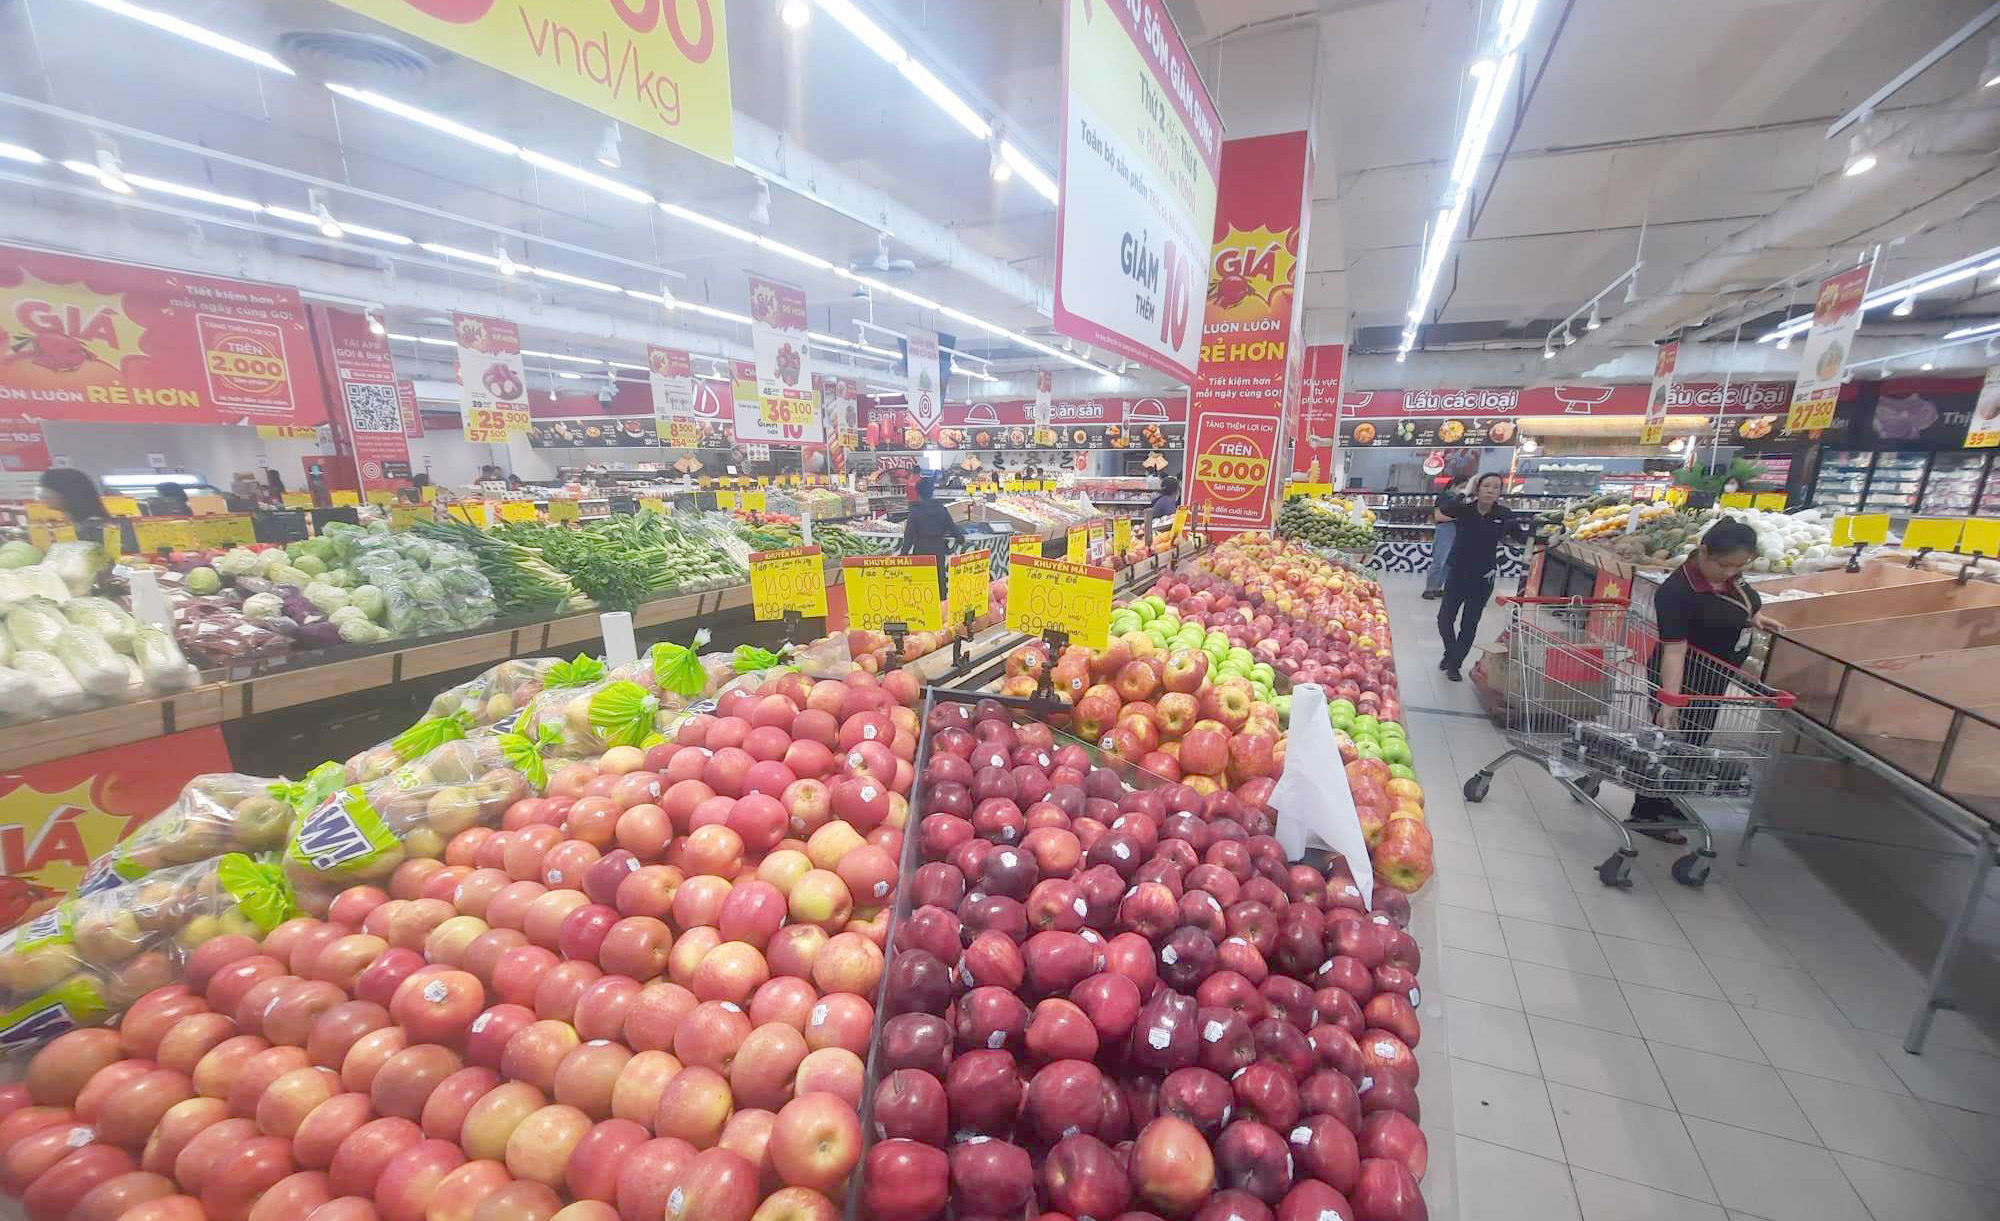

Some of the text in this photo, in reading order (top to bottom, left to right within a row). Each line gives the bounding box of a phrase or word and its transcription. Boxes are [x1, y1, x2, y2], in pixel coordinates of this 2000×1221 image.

[520, 5, 682, 127] vnd/kg
[1170, 55, 1194, 118] GIẢM
[1193, 100, 1213, 156] SUNG
[1158, 102, 1166, 134] 2
[1080, 119, 1103, 157] Toàn
[1104, 141, 1116, 172] bộ
[1215, 242, 1281, 283] GIÁ
[1121, 228, 1159, 295] GIẢM
[1160, 240, 1190, 354] 10
[1135, 294, 1155, 324] THÊM
[16, 301, 120, 351] GIÁ
[1203, 317, 1281, 334] LUÔN LUÔN
[225, 340, 264, 356] TRÊN
[1199, 337, 1226, 362] RẺ
[1229, 340, 1285, 362] HƠN
[210, 354, 283, 377] 2.000
[1208, 375, 1226, 386] Tiết
[1228, 376, 1251, 387] kiệm
[1264, 389, 1282, 397] GO!
[31, 388, 84, 403] LUÔN
[86, 379, 130, 405] RẺ
[132, 387, 201, 409] HƠN
[1404, 389, 1516, 412] Lẩu các loại
[1666, 382, 1692, 406] ẩu
[1696, 385, 1738, 405] các
[766, 398, 812, 422] 36.100
[1058, 404, 1077, 419] ăn
[1943, 411, 1969, 427] Thị
[1219, 441, 1253, 456] TRÊN
[1198, 459, 1266, 482] 2.000
[863, 556, 913, 566] KHUYẾN MÃI
[1033, 559, 1089, 576] KHUYẾN MÃI
[867, 583, 934, 613] 65.000
